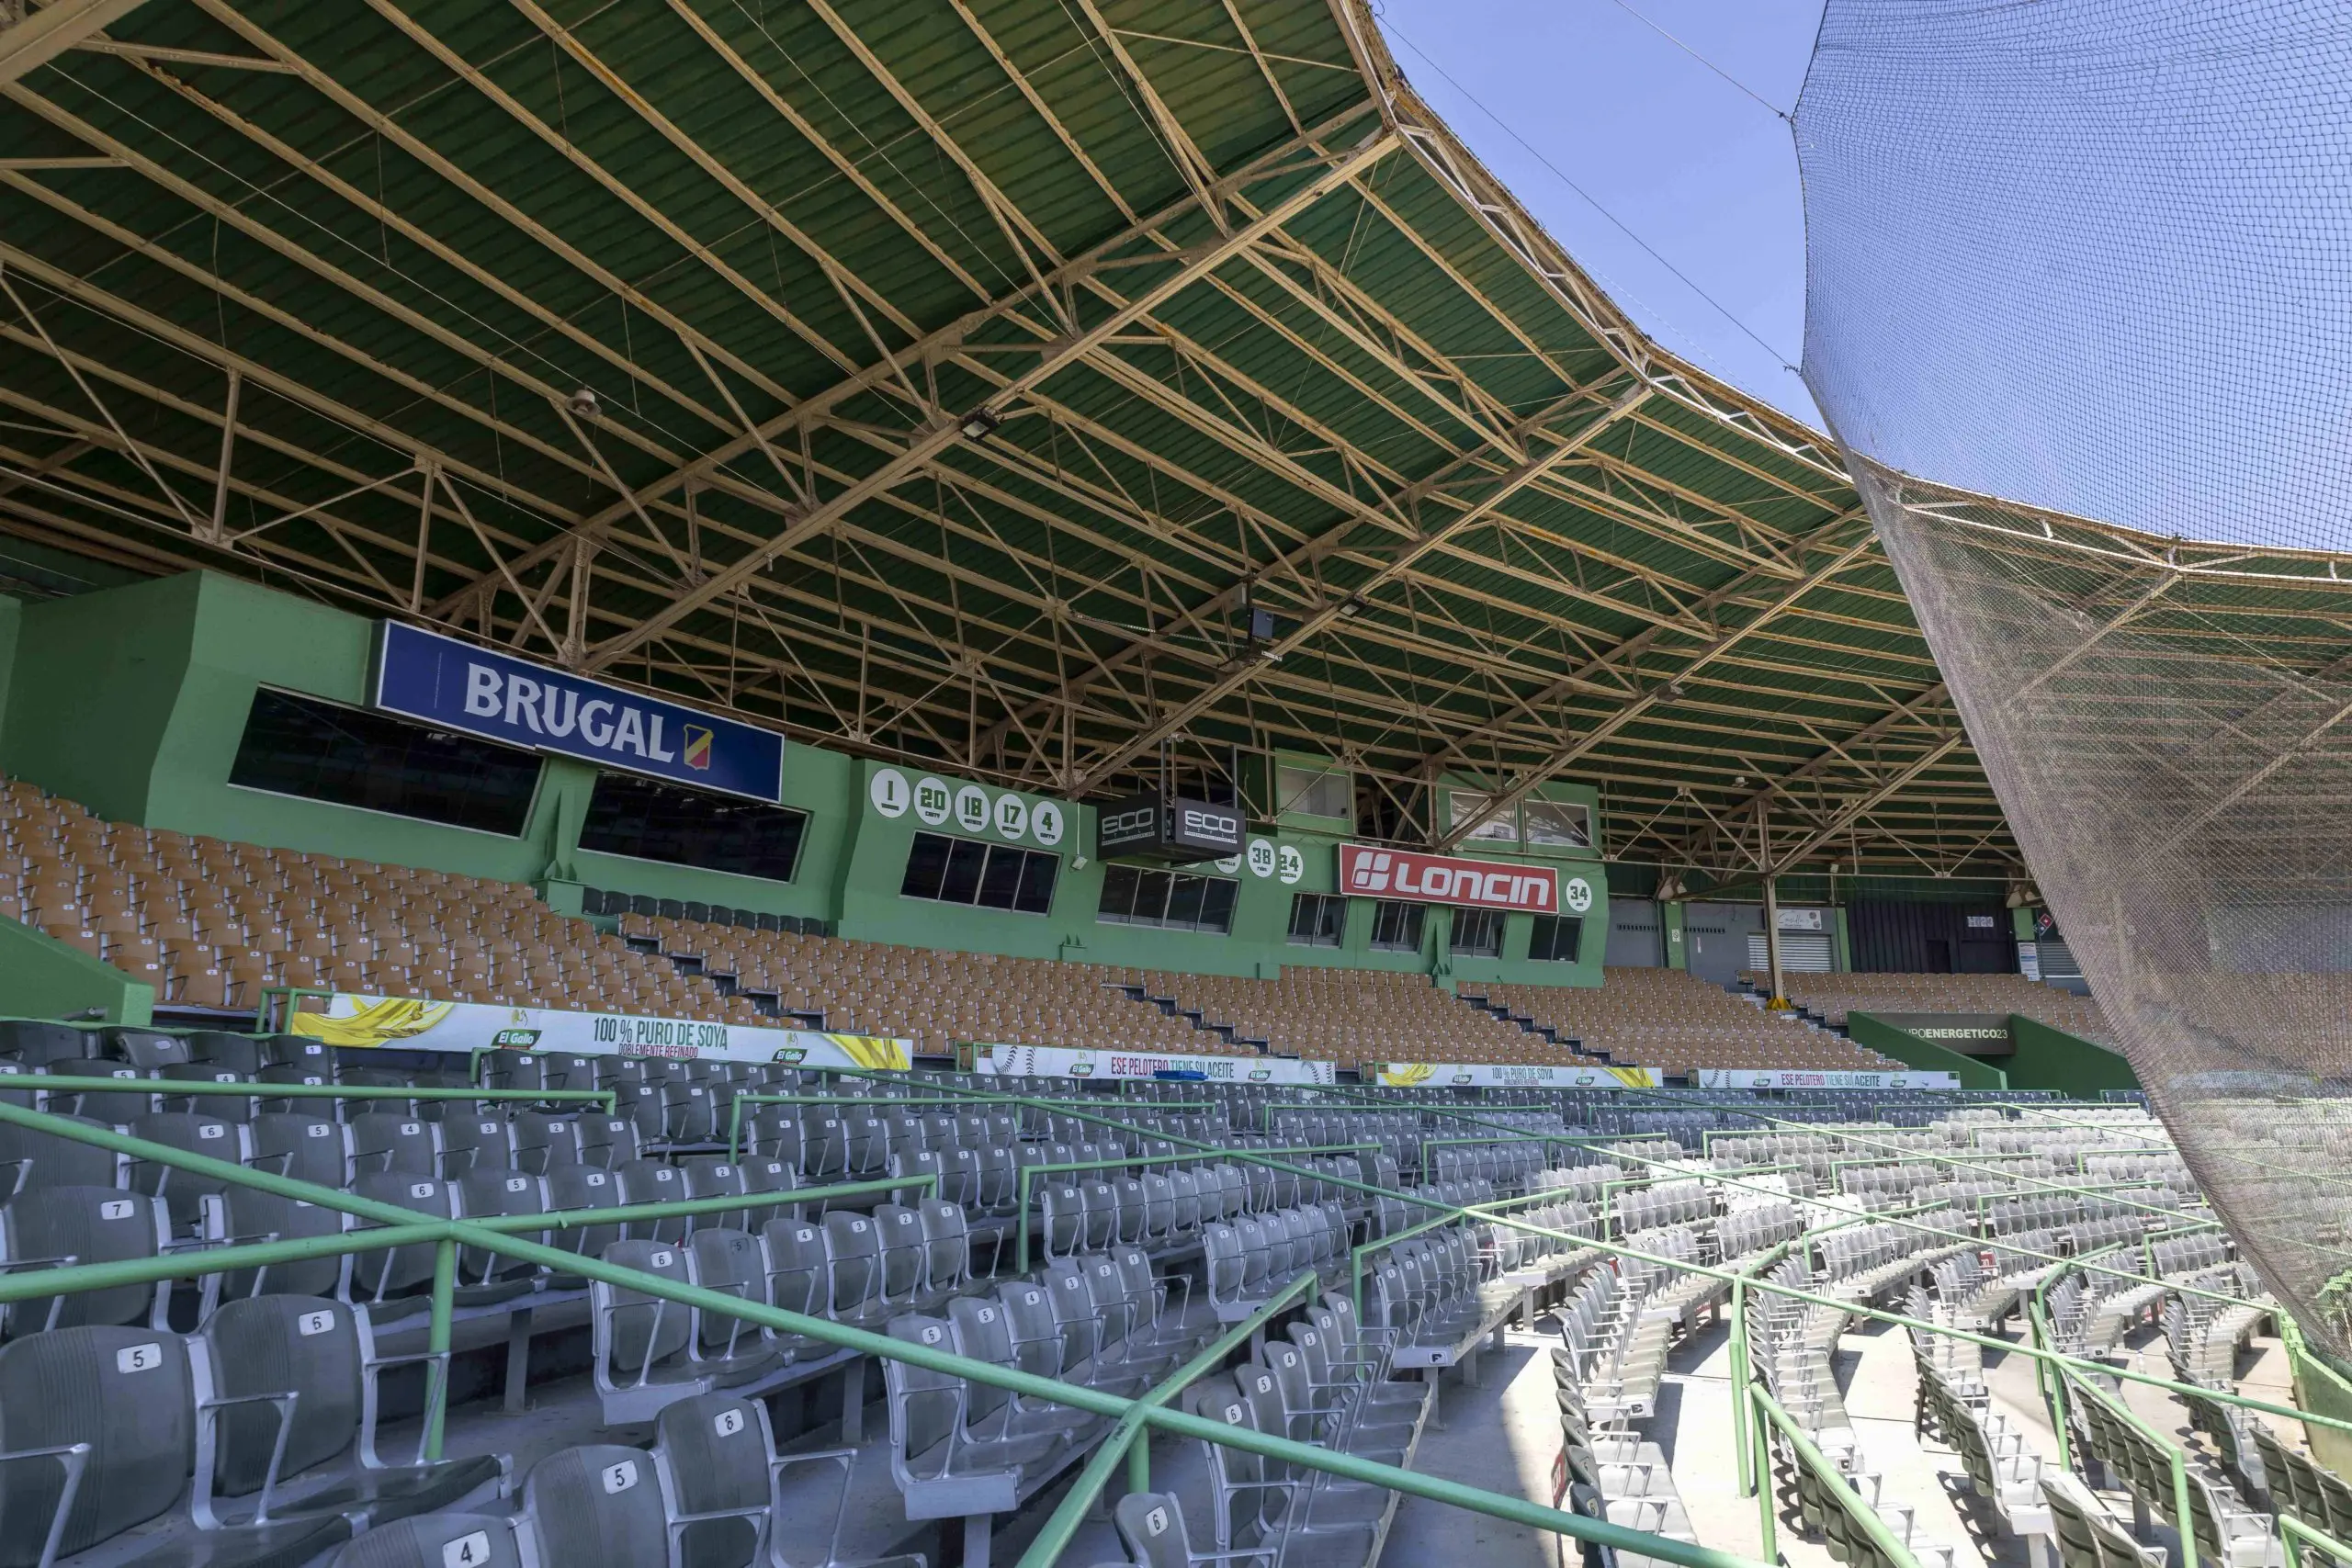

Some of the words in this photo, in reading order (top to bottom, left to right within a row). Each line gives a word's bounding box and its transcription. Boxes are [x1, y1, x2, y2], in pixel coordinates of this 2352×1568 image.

[464, 663, 674, 762] BRUGAL
[888, 781, 893, 800] 1
[921, 787, 945, 810] 20
[965, 795, 982, 817] 18
[1003, 804, 1021, 824] 17
[1102, 807, 1154, 834] ECO
[1041, 812, 1053, 830] 4
[1184, 810, 1237, 833] ECO
[1252, 848, 1271, 864] 38
[1279, 854, 1298, 872] 24
[1395, 862, 1549, 906] LONCIN
[1570, 886, 1588, 900] 34
[498, 1032, 509, 1043] El
[510, 1032, 534, 1044] Gallo
[594, 1017, 616, 1043] 100
[619, 1019, 633, 1043] %
[637, 1021, 673, 1045] PURO
[677, 1022, 694, 1046] DE
[697, 1023, 729, 1050] SOYA
[618, 1043, 662, 1056] DOBLEMENTE
[665, 1045, 698, 1058] REFINADO
[776, 1050, 785, 1059] El
[786, 1051, 802, 1061] Gallo
[1111, 1057, 1126, 1075] ESE
[1128, 1058, 1169, 1076] PELOTERO
[1207, 1062, 1234, 1078] ACEITE
[1492, 1067, 1502, 1079] 100
[1510, 1067, 1527, 1079] PURO
[1528, 1067, 1535, 1079] DE
[1537, 1068, 1554, 1080] SOYA
[1781, 1074, 1794, 1086] ESE
[1795, 1074, 1825, 1086] PELOTERO
[1826, 1075, 1843, 1086] TIENE
[1844, 1075, 1851, 1086] SU
[1855, 1076, 1880, 1087] ACEITE
[208, 1127, 215, 1136] 6
[315, 1126, 322, 1135] 5
[661, 1171, 667, 1179] 3
[719, 1168, 726, 1177] 2
[514, 1180, 520, 1190] 5
[593, 1176, 599, 1184] 4
[419, 1186, 426, 1196] 6
[112, 1203, 121, 1216] 7
[902, 1215, 909, 1224] 2
[856, 1222, 862, 1231] 3
[802, 1231, 808, 1239] 4
[658, 1255, 665, 1265] 6
[1102, 1267, 1107, 1276] 2
[1069, 1279, 1075, 1288] 3
[1029, 1293, 1035, 1303] 4
[982, 1310, 989, 1321] 5
[1324, 1317, 1329, 1327] 2
[312, 1316, 322, 1330] 6
[928, 1329, 935, 1340] 6
[1307, 1335, 1313, 1344] 3
[133, 1349, 144, 1368] 5
[1287, 1355, 1293, 1364] 4
[1431, 1353, 1442, 1362] F
[1261, 1379, 1267, 1391] 5
[1230, 1408, 1237, 1420] 6
[725, 1415, 734, 1430] 6
[615, 1468, 626, 1487] 5
[1590, 1502, 1596, 1515] 6
[1152, 1514, 1161, 1530] 6
[460, 1541, 472, 1562] 4
